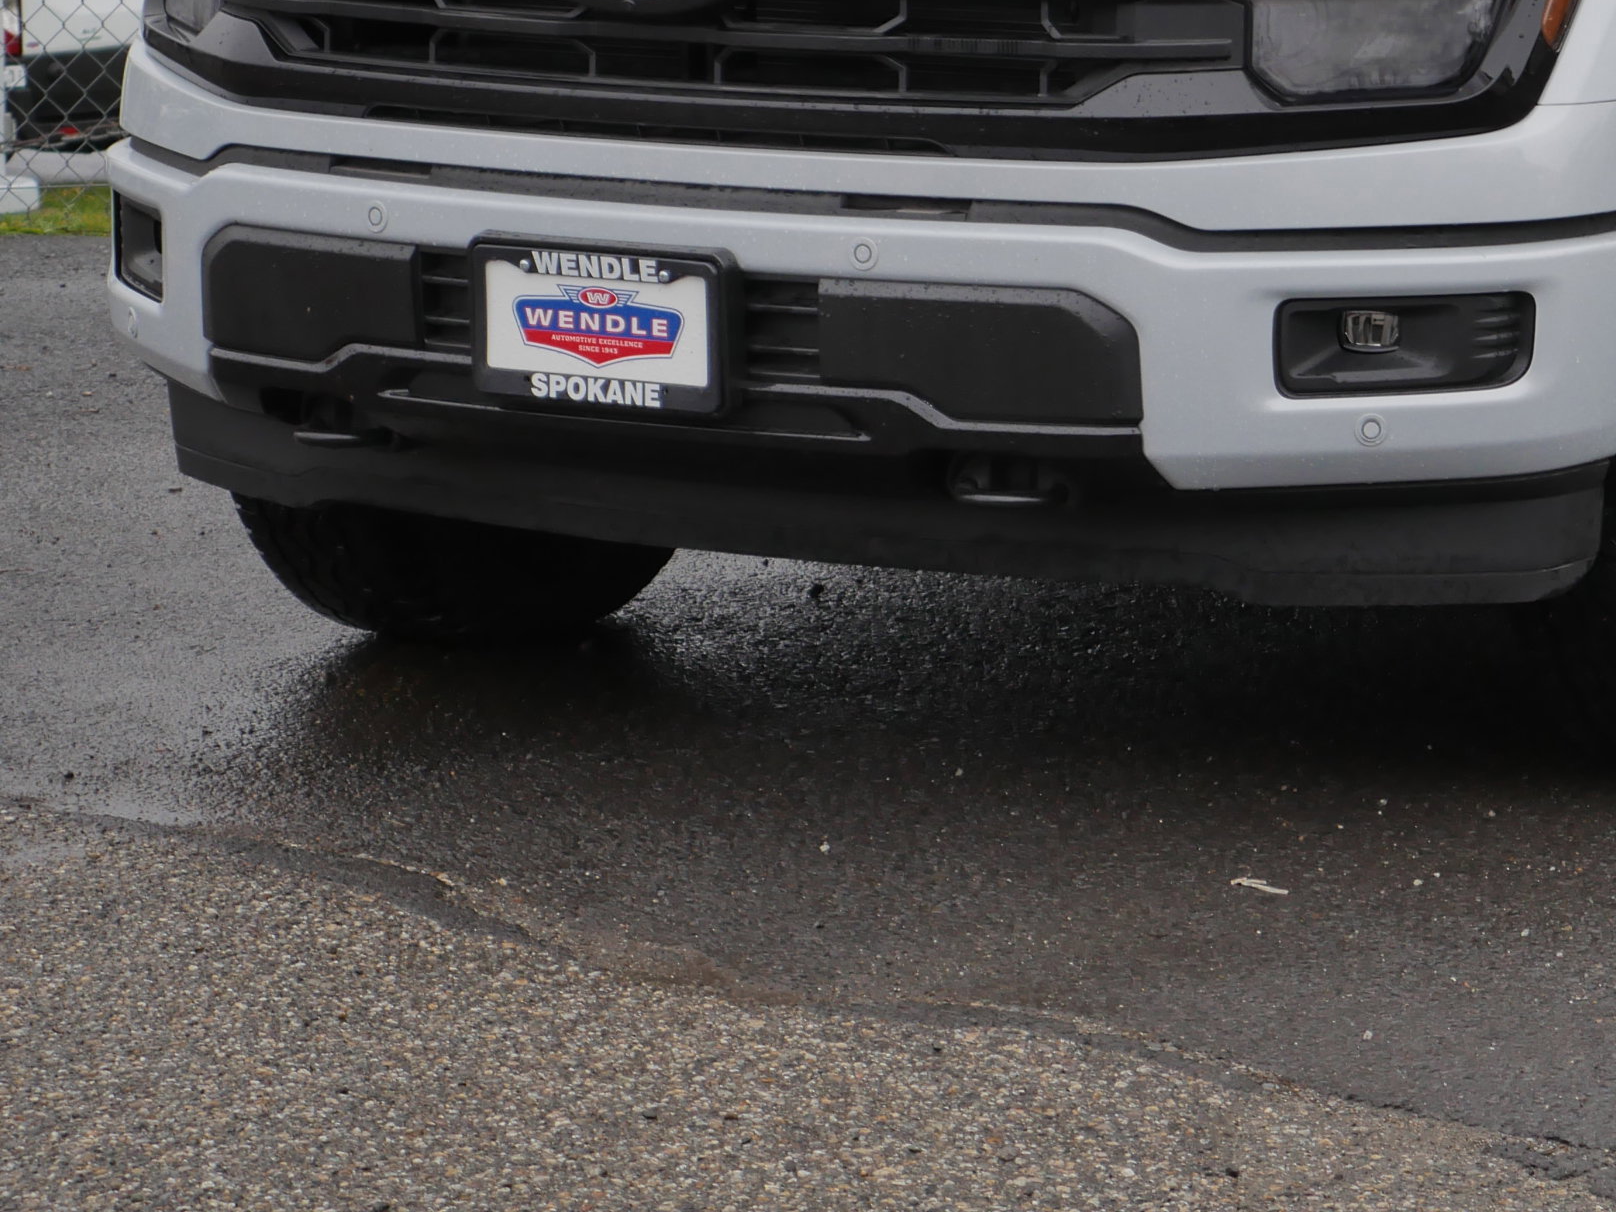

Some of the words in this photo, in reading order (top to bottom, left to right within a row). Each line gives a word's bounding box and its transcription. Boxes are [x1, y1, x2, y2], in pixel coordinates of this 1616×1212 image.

[533, 251, 659, 282] WENDLE
[524, 307, 668, 338] WENDLE
[551, 334, 597, 344] AUTOMOTIVE
[599, 338, 644, 348] EXCELLENCE
[578, 345, 599, 353] SINCE
[531, 372, 661, 408] SPOKANE
